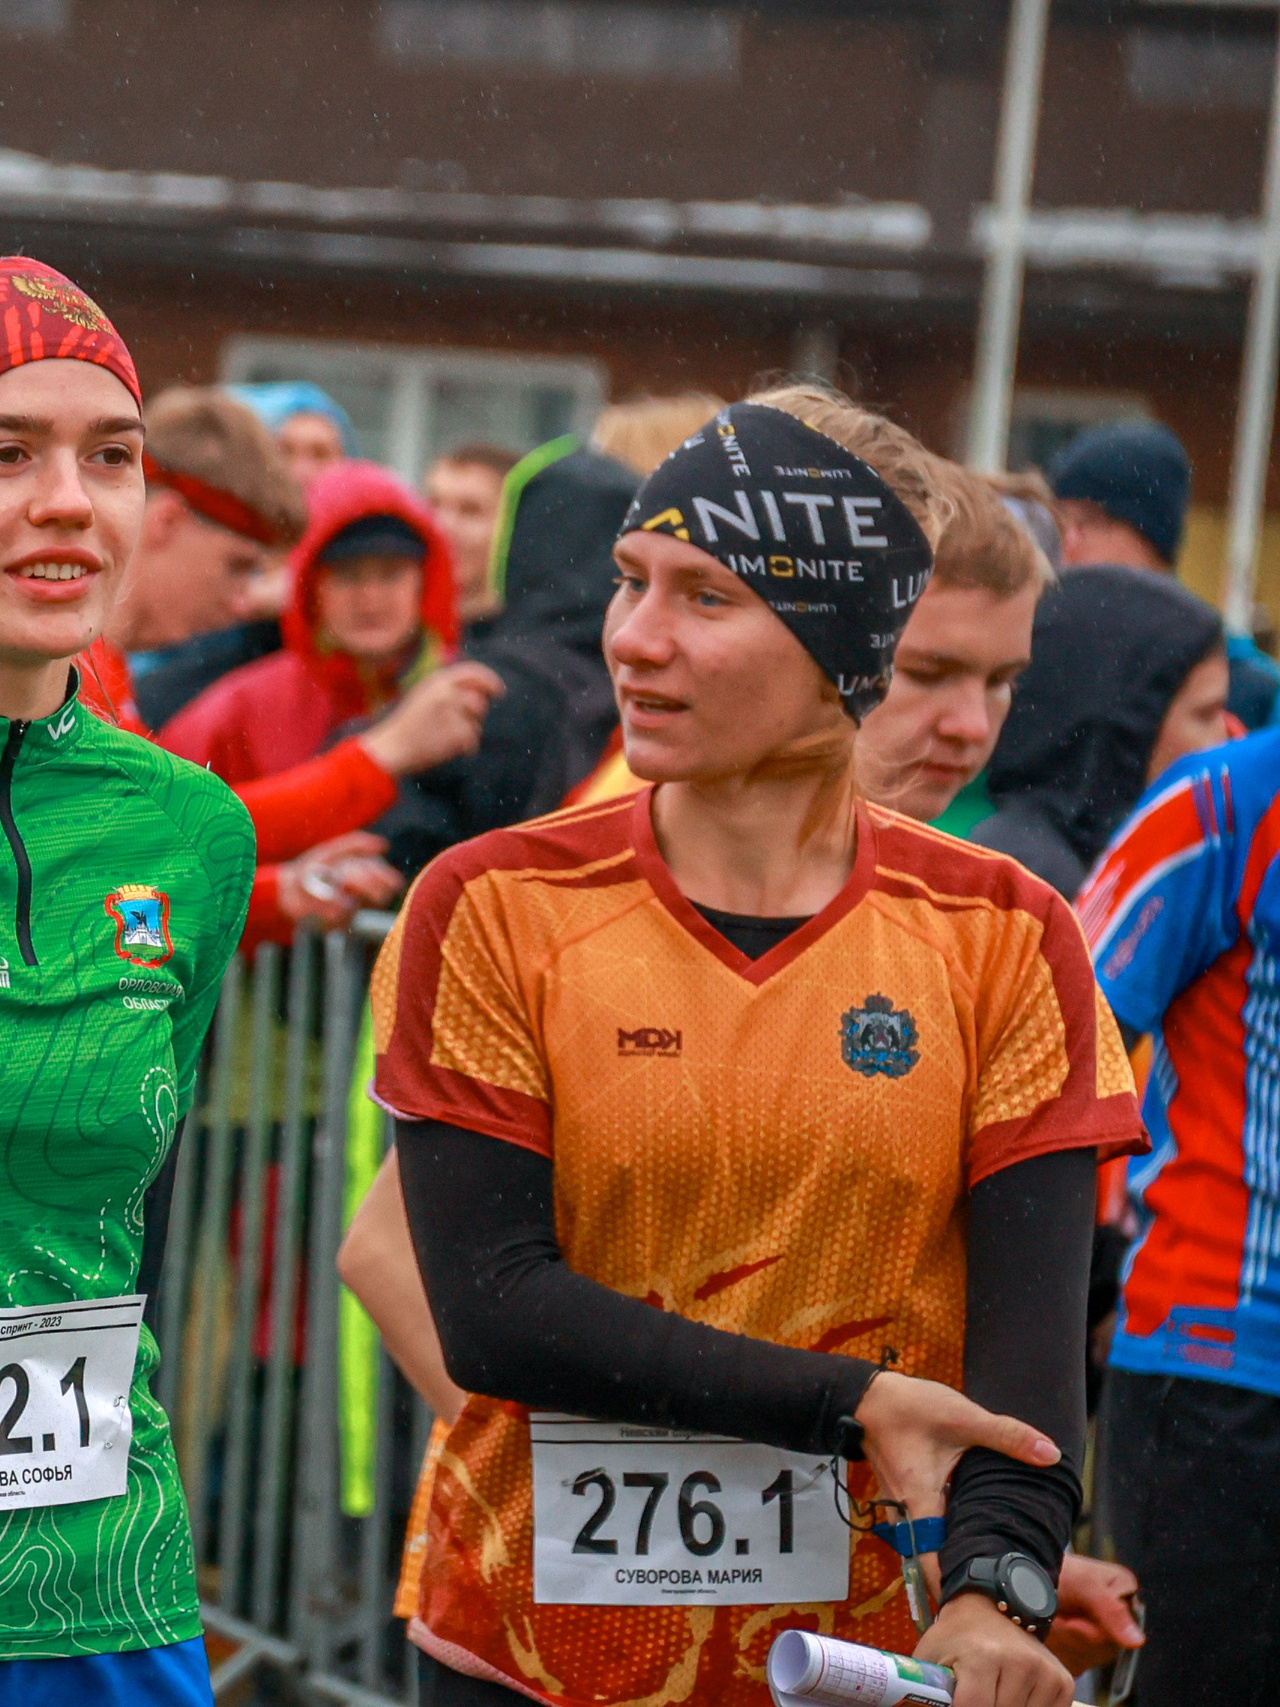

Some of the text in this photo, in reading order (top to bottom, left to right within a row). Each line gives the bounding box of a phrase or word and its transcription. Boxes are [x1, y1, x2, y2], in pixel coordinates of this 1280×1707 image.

[0, 1322, 33, 1336] спринт
[39, 1316, 62, 1328] 2023
[22, 1464, 72, 1483] СОФЬЯ
[572, 1470, 793, 1556] 276.1
[616, 1568, 762, 1584] СУВОРОВА МАРИЯ
